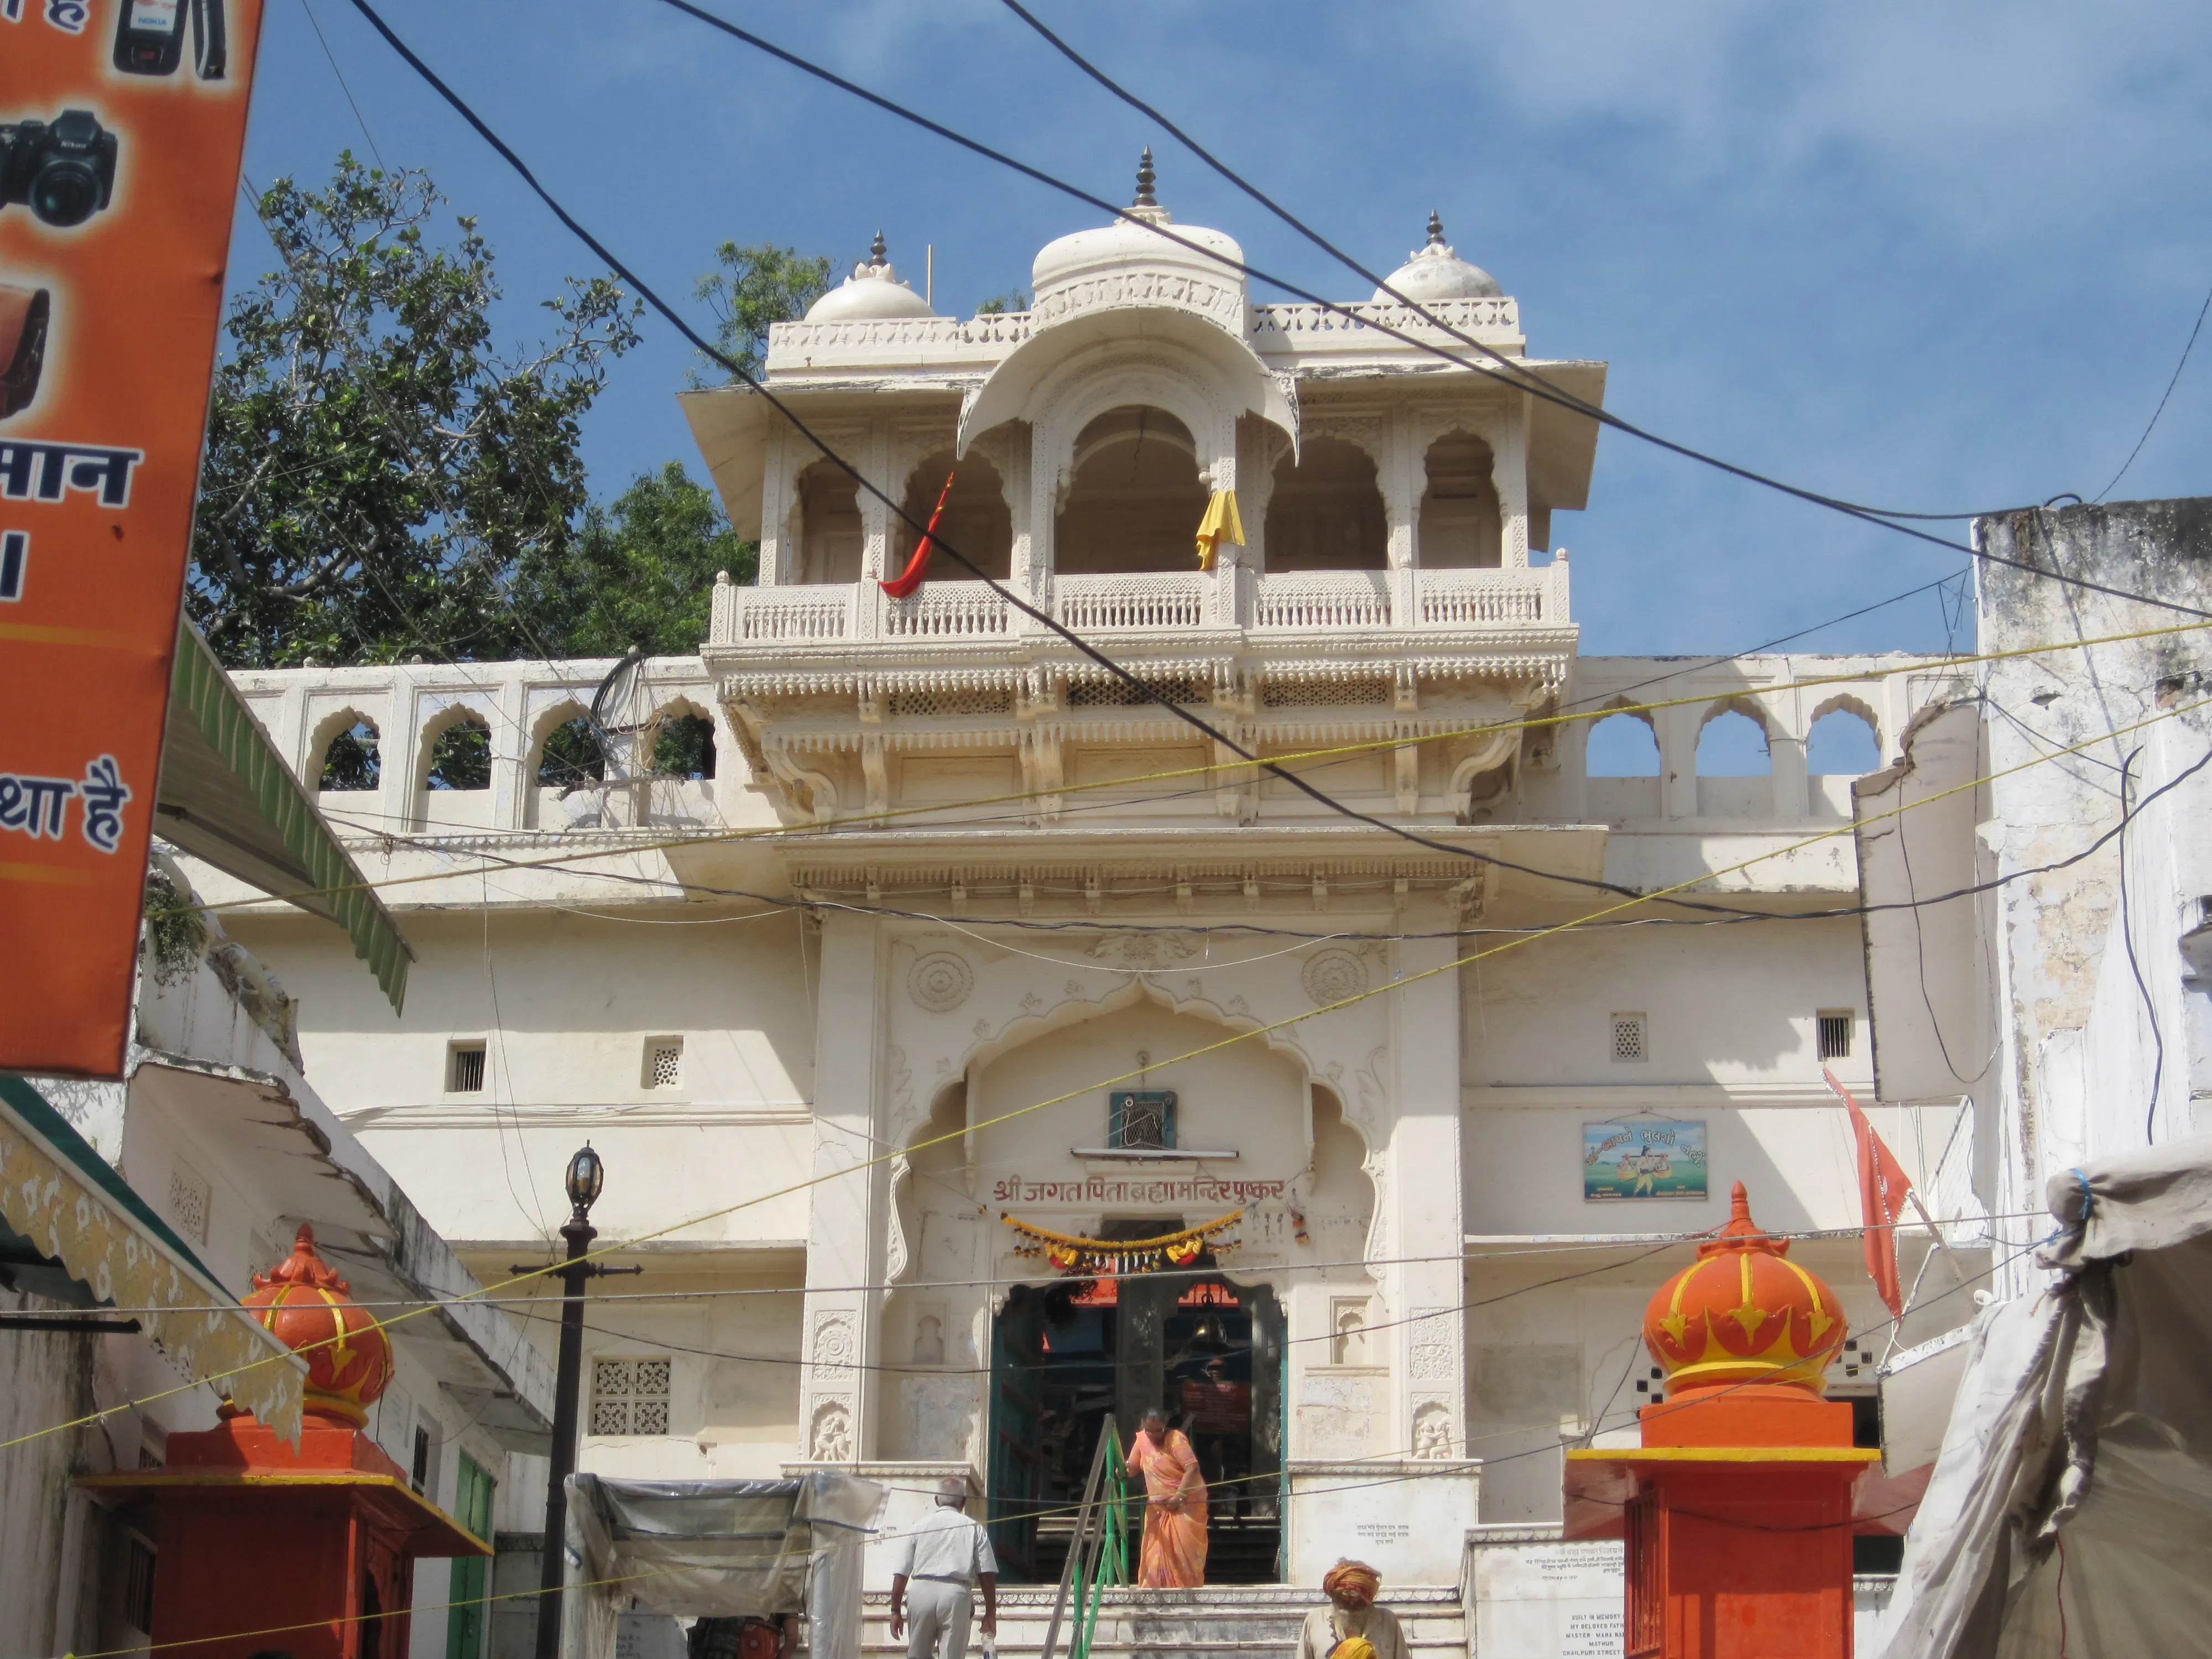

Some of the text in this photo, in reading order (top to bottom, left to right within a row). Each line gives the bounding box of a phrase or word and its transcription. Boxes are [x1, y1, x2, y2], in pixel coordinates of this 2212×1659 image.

[61, 140, 86, 149] Nikon
[81, 757, 129, 851] है
[993, 1174, 1022, 1201] श्री
[1024, 1182, 1083, 1202] जगत
[1085, 1176, 1128, 1202] पिता
[1231, 1180, 1285, 1205] पुष्कर
